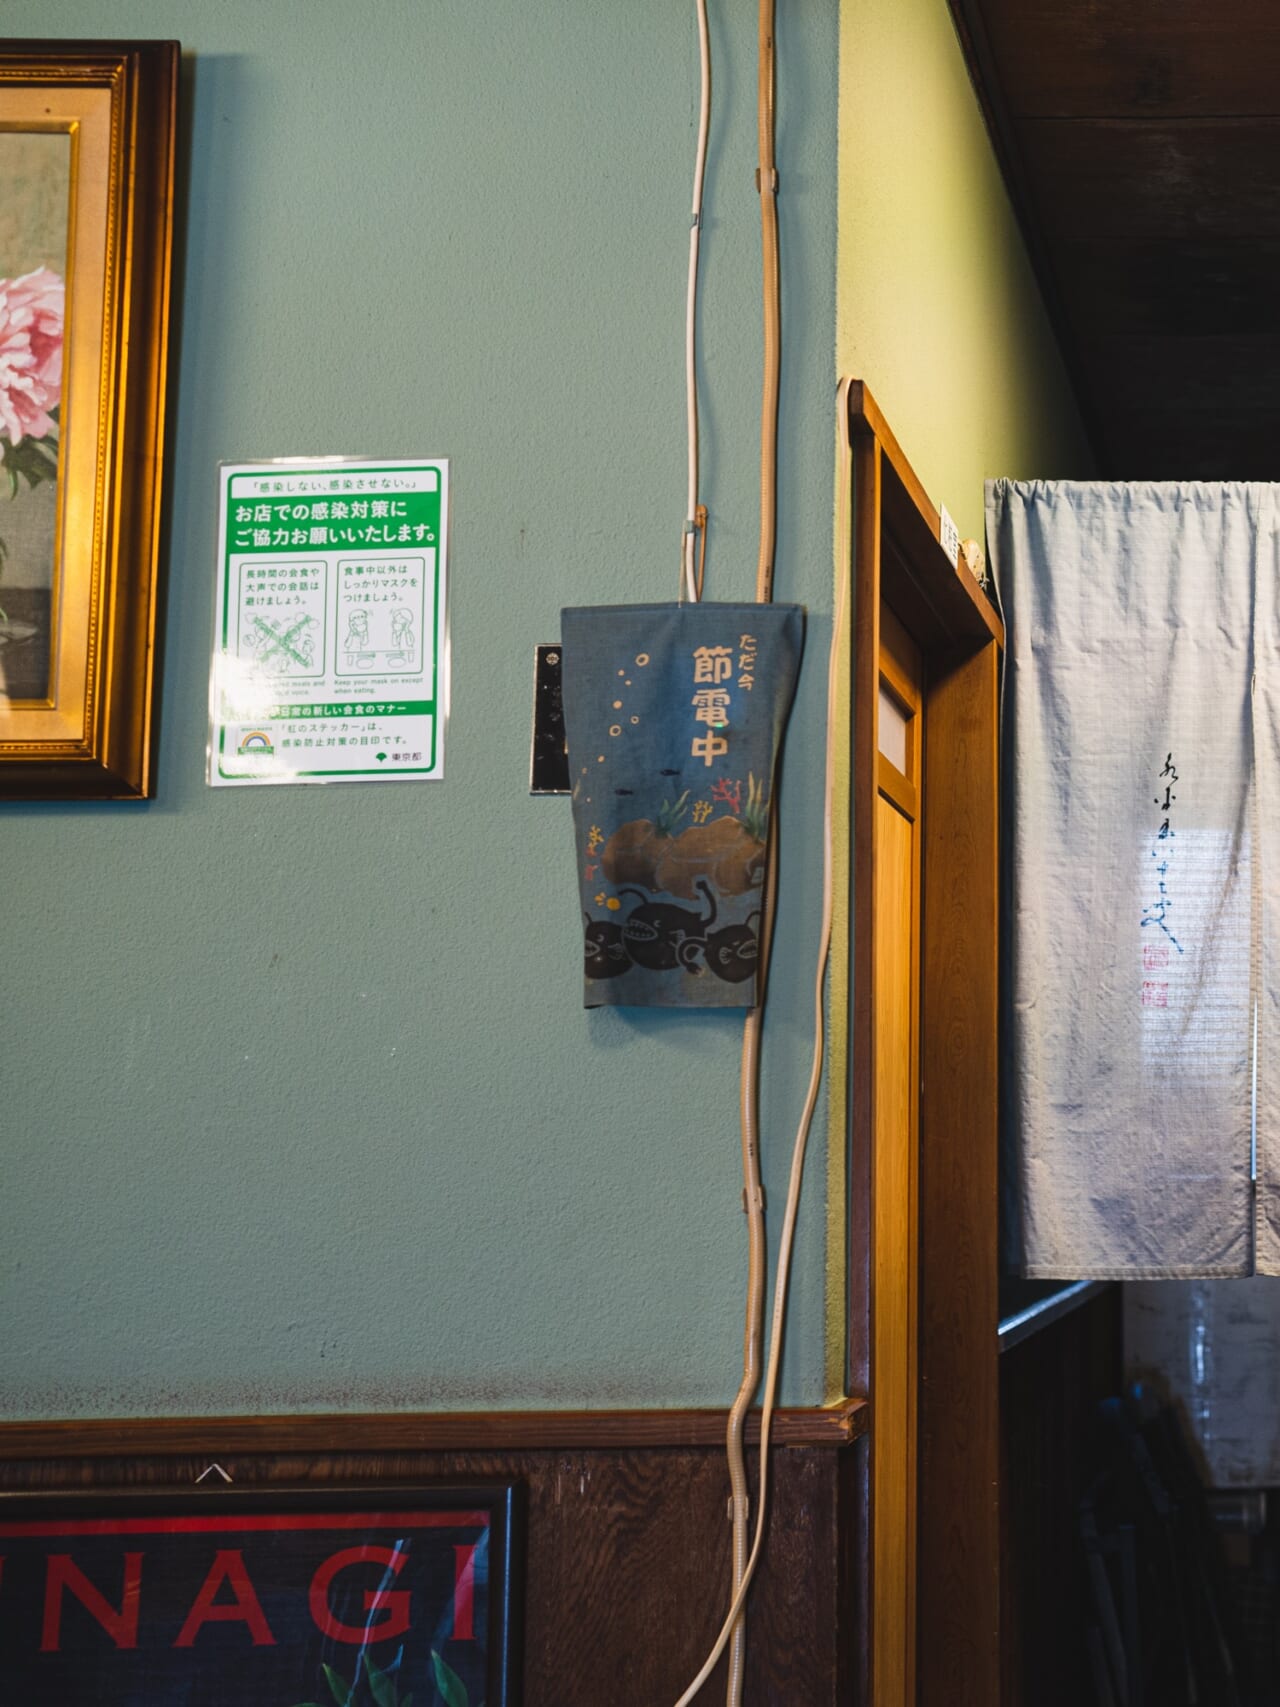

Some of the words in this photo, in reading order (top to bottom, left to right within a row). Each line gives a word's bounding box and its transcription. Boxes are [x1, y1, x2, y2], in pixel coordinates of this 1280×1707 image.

[235, 500, 407, 523] お店での感染対策に
[235, 523, 435, 547] ご協力お願いいたします。
[246, 568, 320, 579] 長時間の会食や
[344, 565, 408, 576] 食事中以外は
[245, 581, 319, 592] 大声での会話は
[344, 578, 418, 589] しっかりマスクを
[245, 595, 307, 606] 避けましょう。
[343, 592, 403, 603] つけましょう。
[738, 633, 758, 691] ただ今
[334, 679, 350, 687] Keep
[370, 677, 388, 685] mask
[401, 676, 424, 685] except
[690, 645, 735, 767] 節電中
[391, 752, 422, 762] 東京都
[0, 1543, 480, 1652] NAGI
